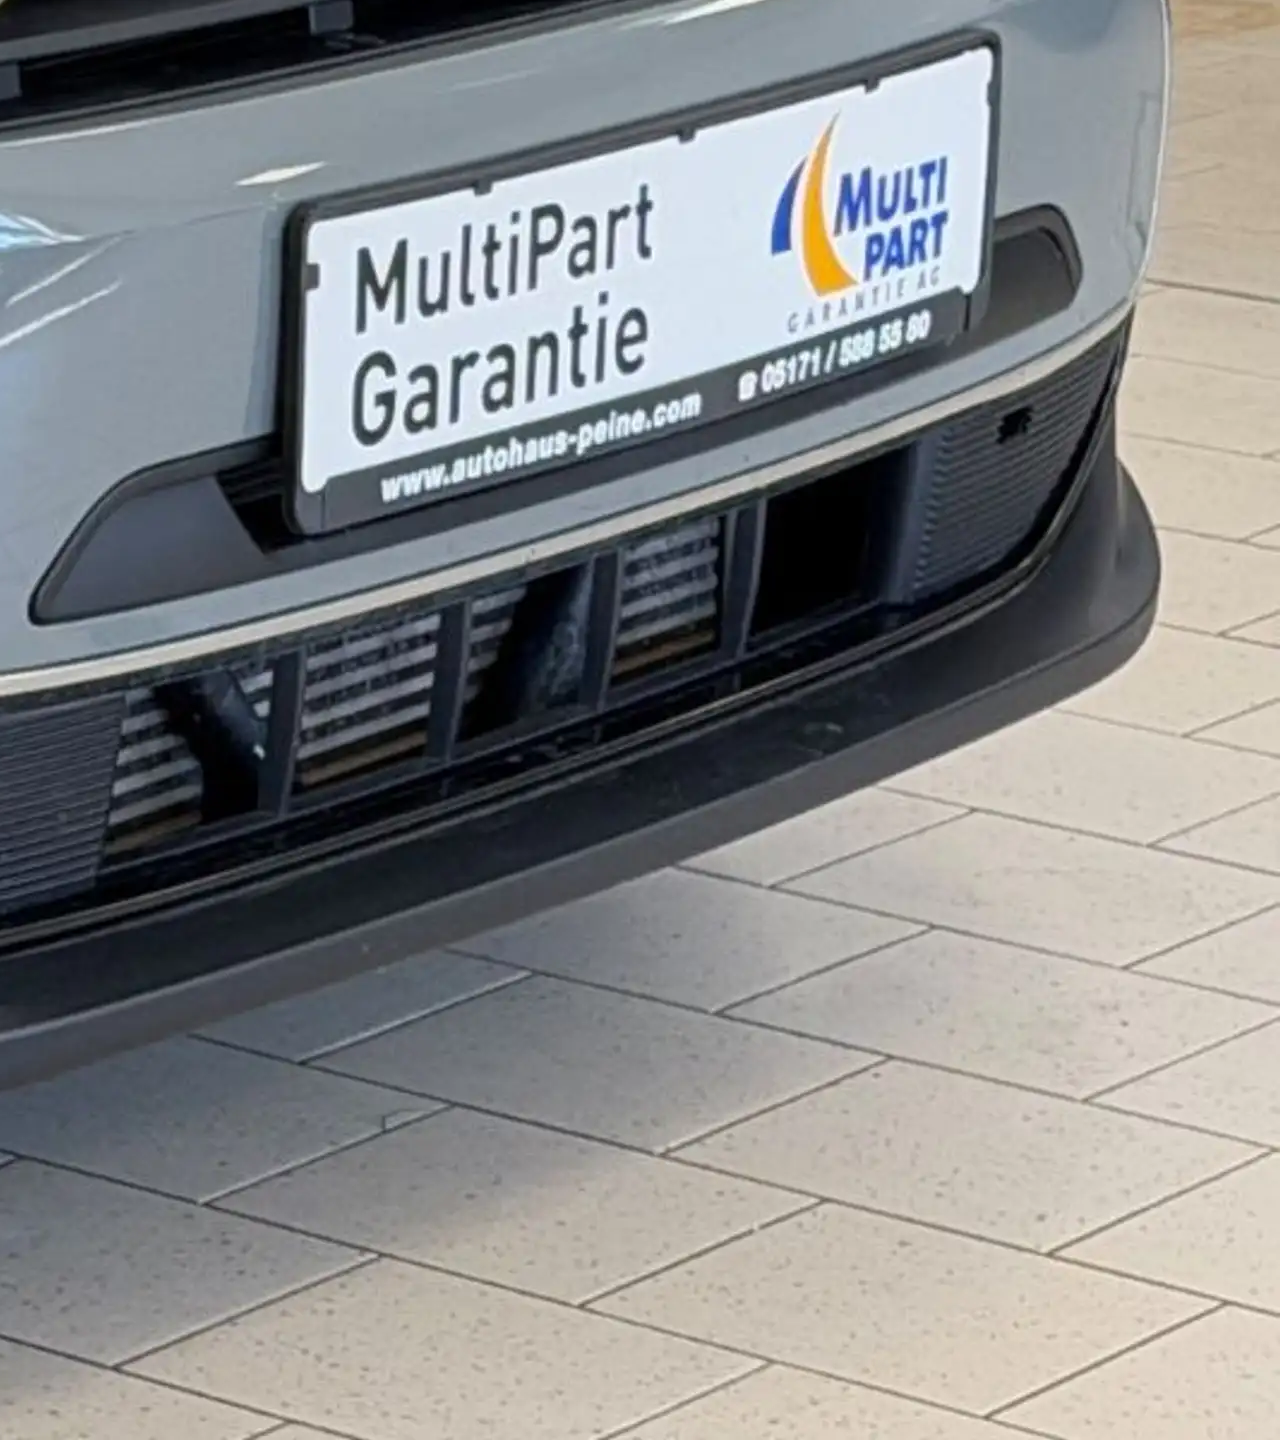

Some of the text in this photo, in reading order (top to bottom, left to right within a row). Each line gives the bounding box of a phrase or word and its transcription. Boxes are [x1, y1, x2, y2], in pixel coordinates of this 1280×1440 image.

[834, 156, 948, 237] MULTI
[355, 183, 654, 336] MultiPart
[863, 210, 949, 282] PART
[787, 266, 941, 333] GARANTIE AG
[351, 290, 649, 448] Garantie
[760, 345, 822, 393] 05171
[380, 391, 703, 504] www.autohaus-peine.com
